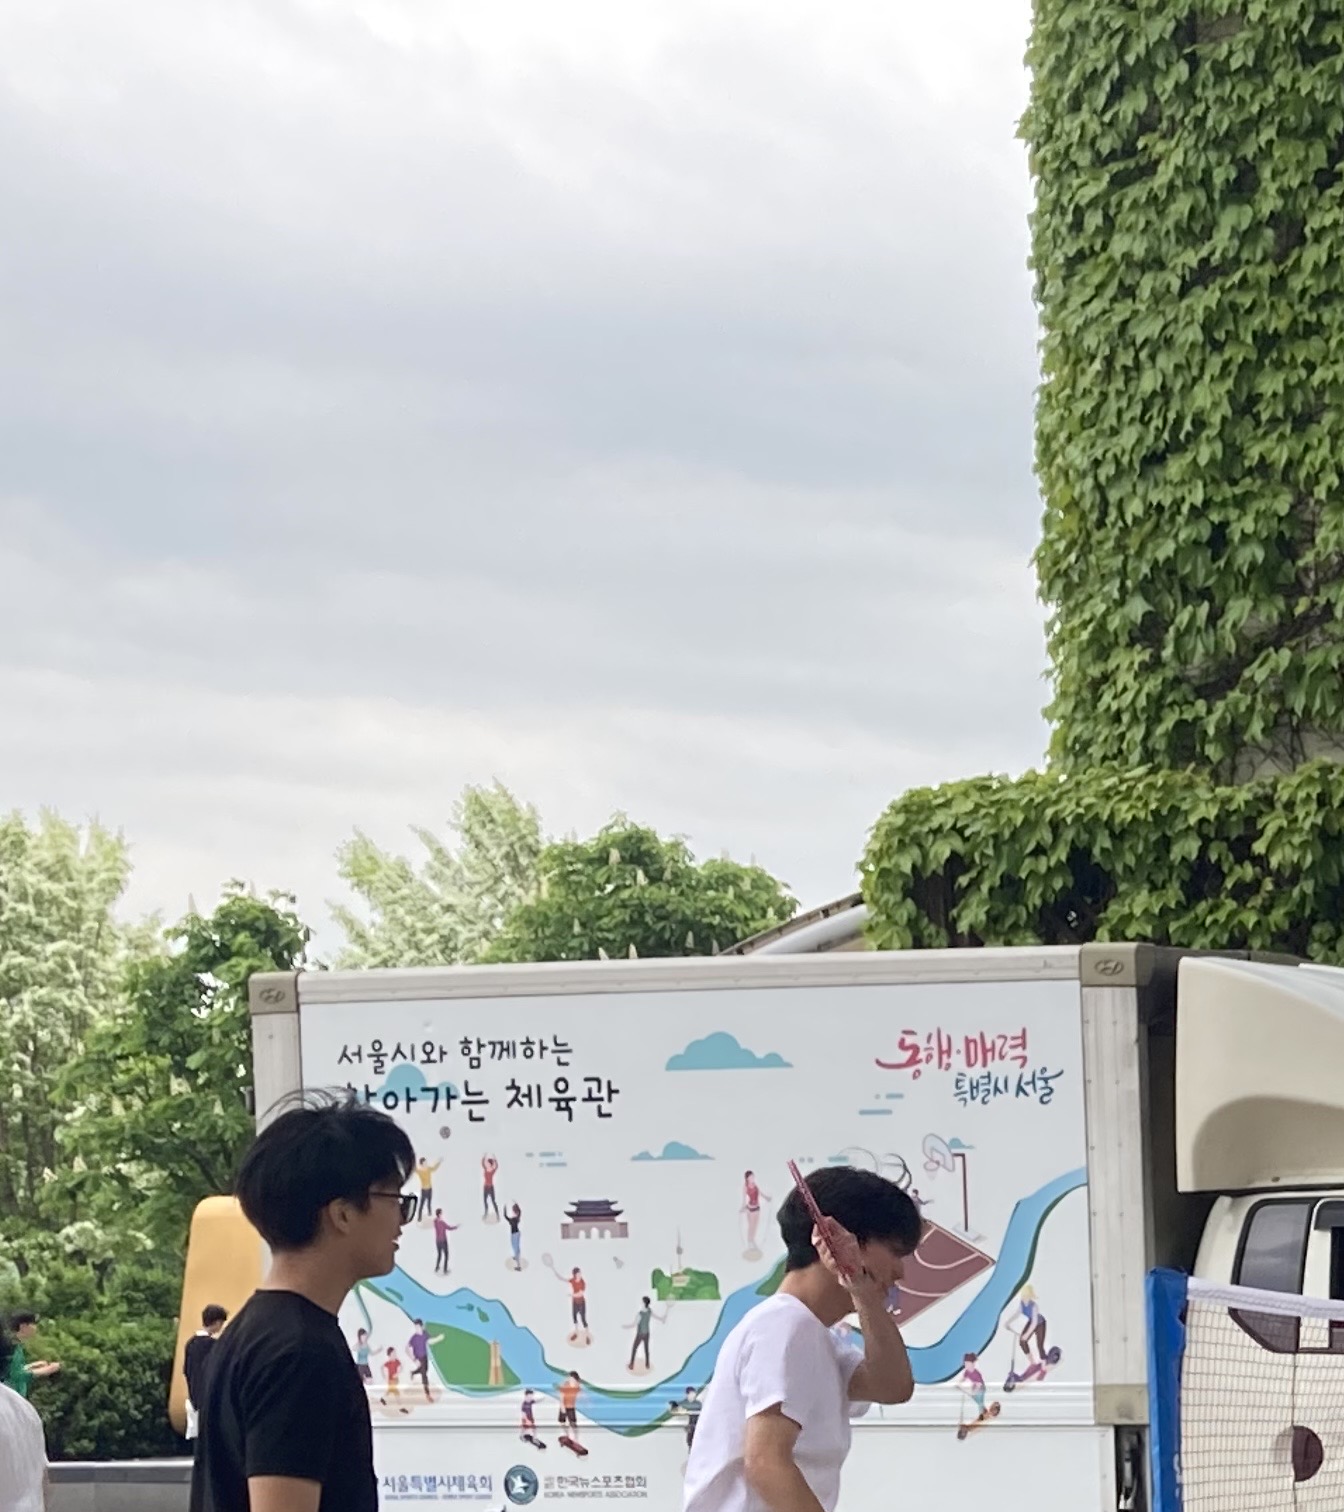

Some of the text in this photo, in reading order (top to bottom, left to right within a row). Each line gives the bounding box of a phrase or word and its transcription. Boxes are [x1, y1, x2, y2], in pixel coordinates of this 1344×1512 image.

[337, 1034, 573, 1075] 서울시와 함께하는
[504, 1076, 620, 1123] 체육관
[953, 1066, 1065, 1107] 특별시 서울
[383, 1474, 493, 1493] 서울특별시체육회
